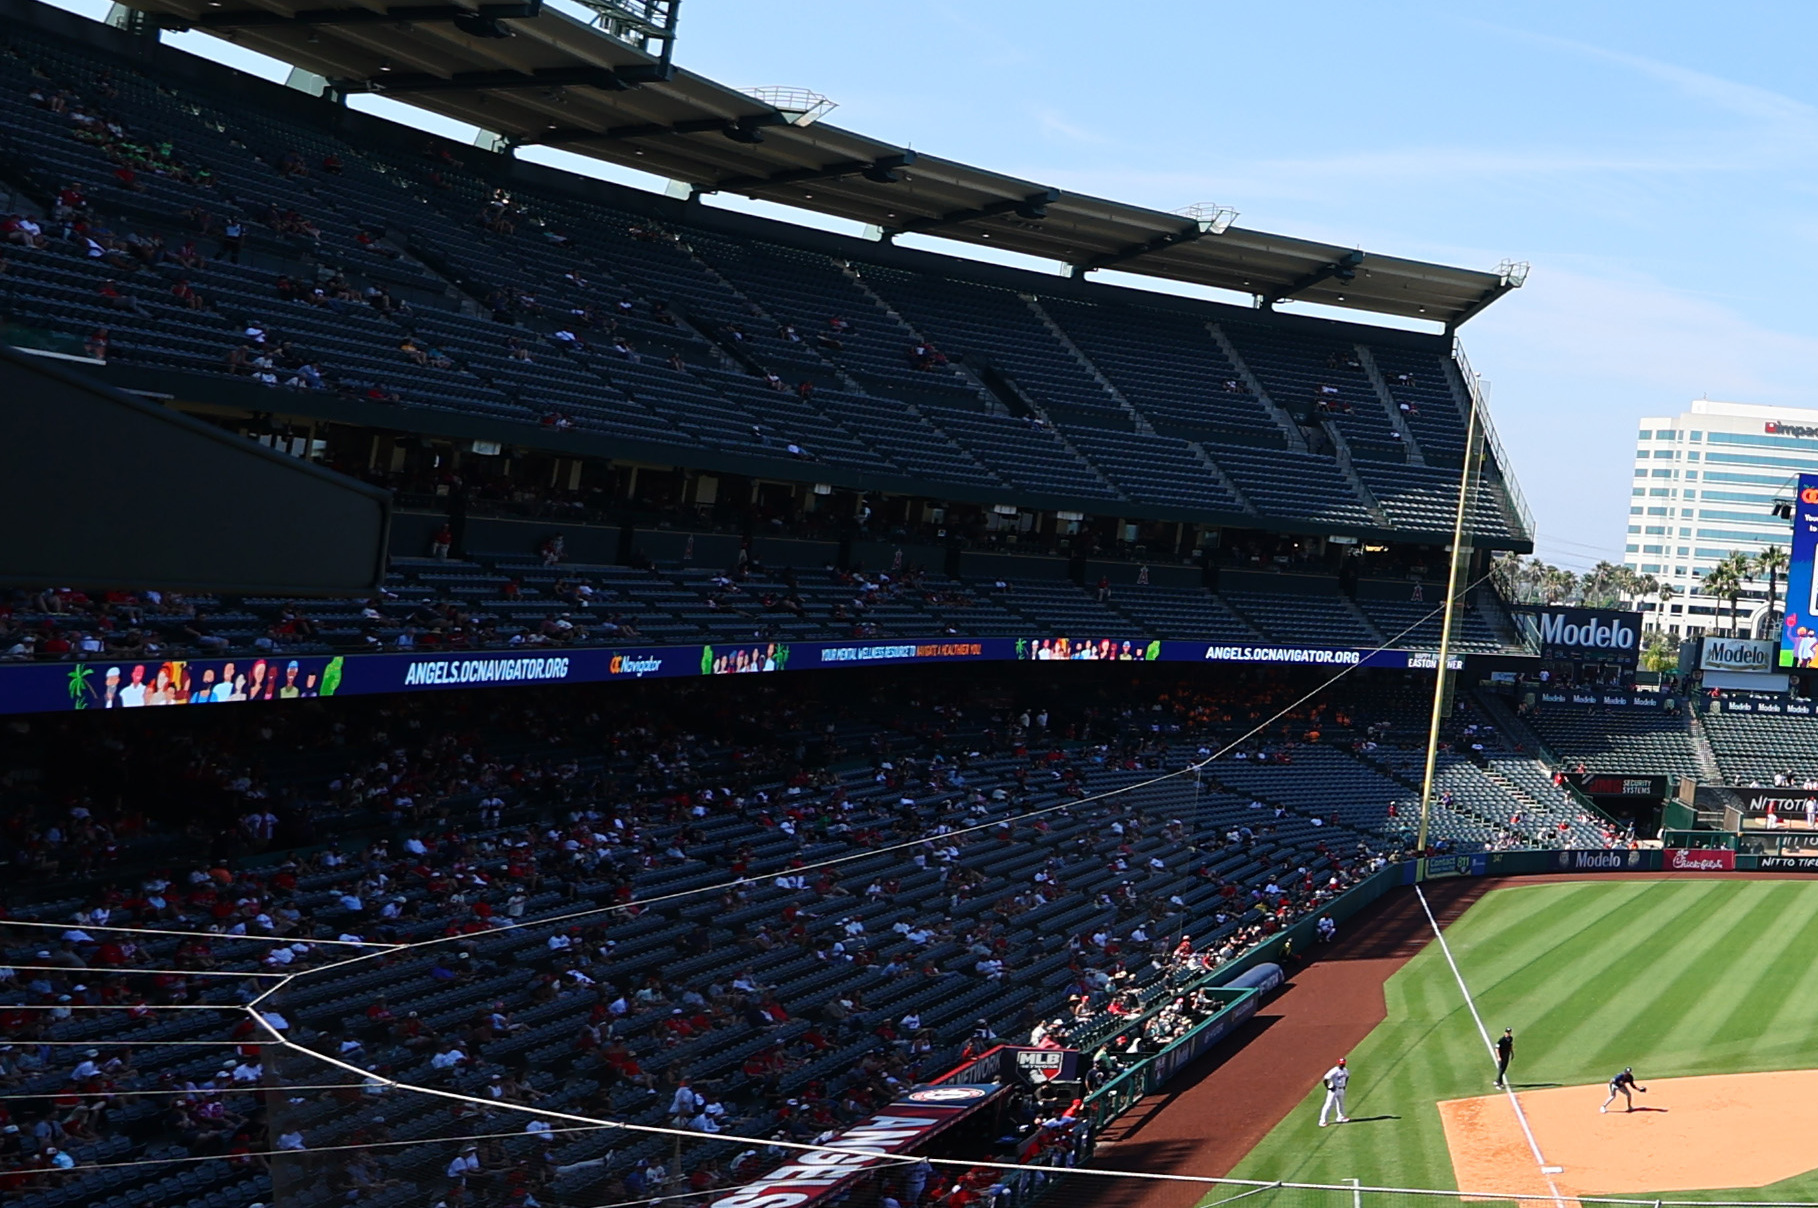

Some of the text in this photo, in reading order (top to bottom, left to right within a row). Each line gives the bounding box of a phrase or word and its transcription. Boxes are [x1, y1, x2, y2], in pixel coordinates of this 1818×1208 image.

[1540, 613, 1634, 649] Modelo
[1205, 646, 1360, 664] ANGELS.OCNAVIGATOR.ORG
[1712, 642, 1764, 663] Modelo
[405, 656, 569, 686] ANGELS.OCNAVIGATOR.ORG
[620, 656, 662, 677] Navigator
[1408, 658, 1437, 669] EASTON
[1576, 852, 1621, 868] Modelo
[1761, 857, 1797, 868] NITTO
[1019, 1053, 1060, 1065] MLB
